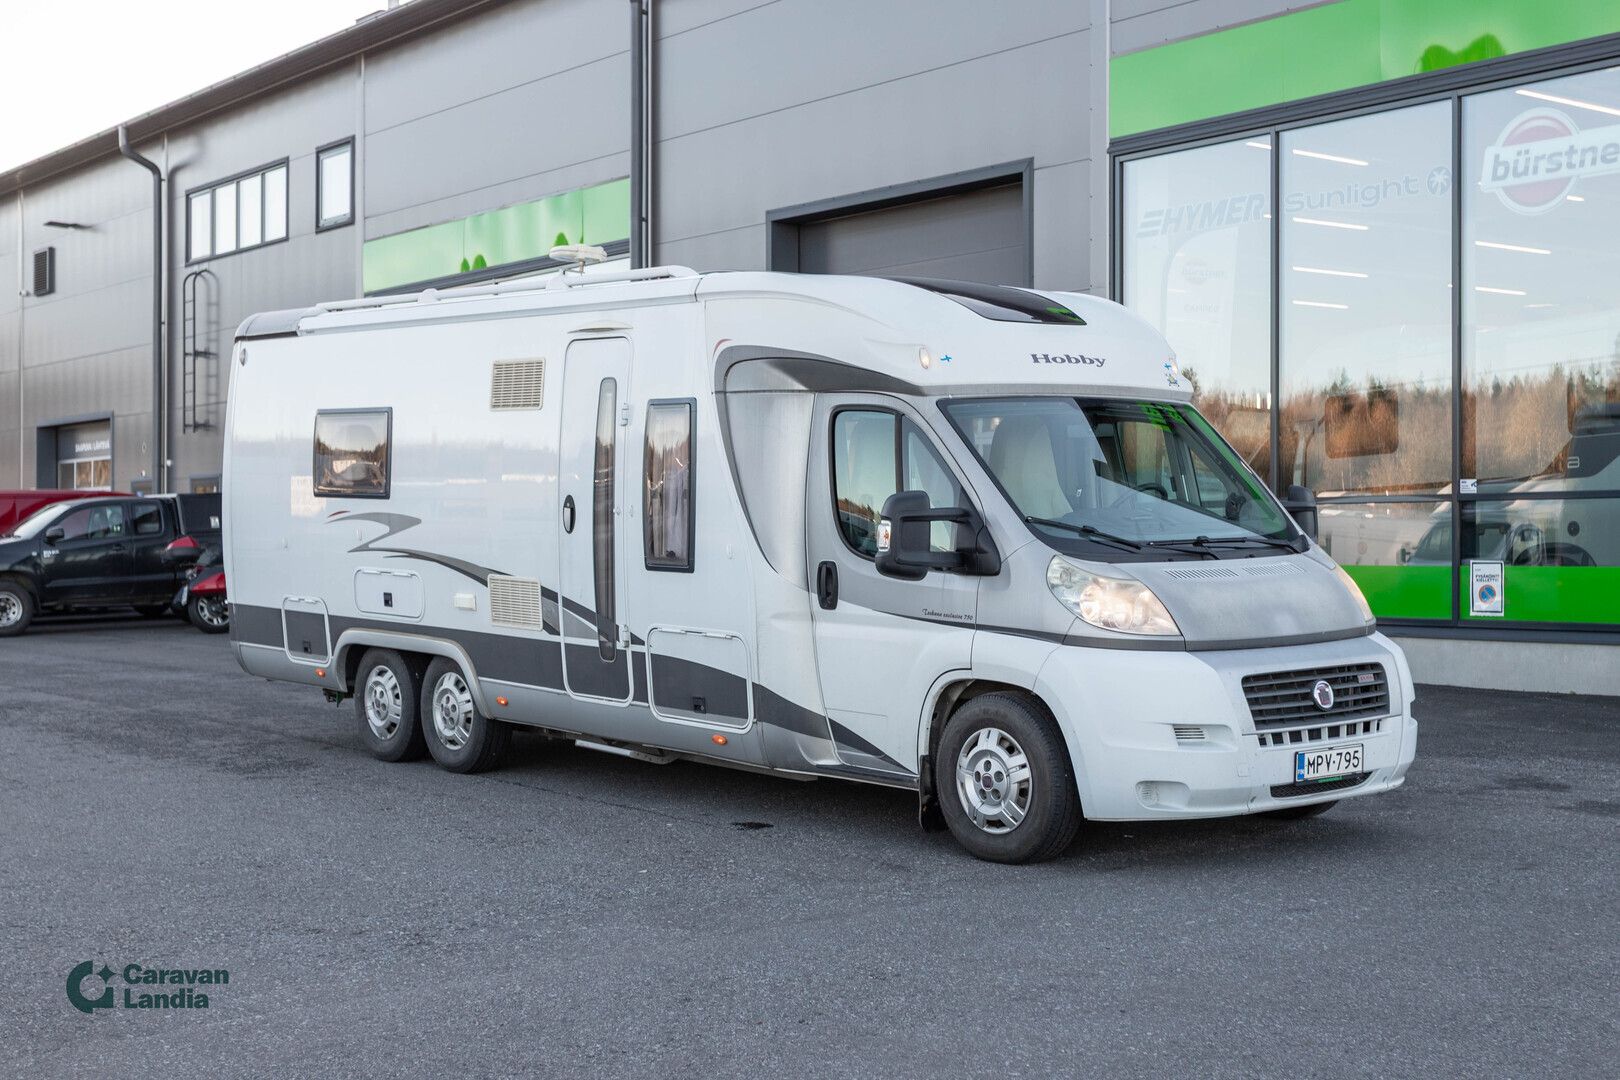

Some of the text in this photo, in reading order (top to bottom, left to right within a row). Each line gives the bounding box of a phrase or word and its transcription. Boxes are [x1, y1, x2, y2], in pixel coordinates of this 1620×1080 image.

[1160, 192, 1266, 235] HYMER
[1031, 353, 1106, 368] Hobby
[1306, 750, 1360, 775] MPV-795
